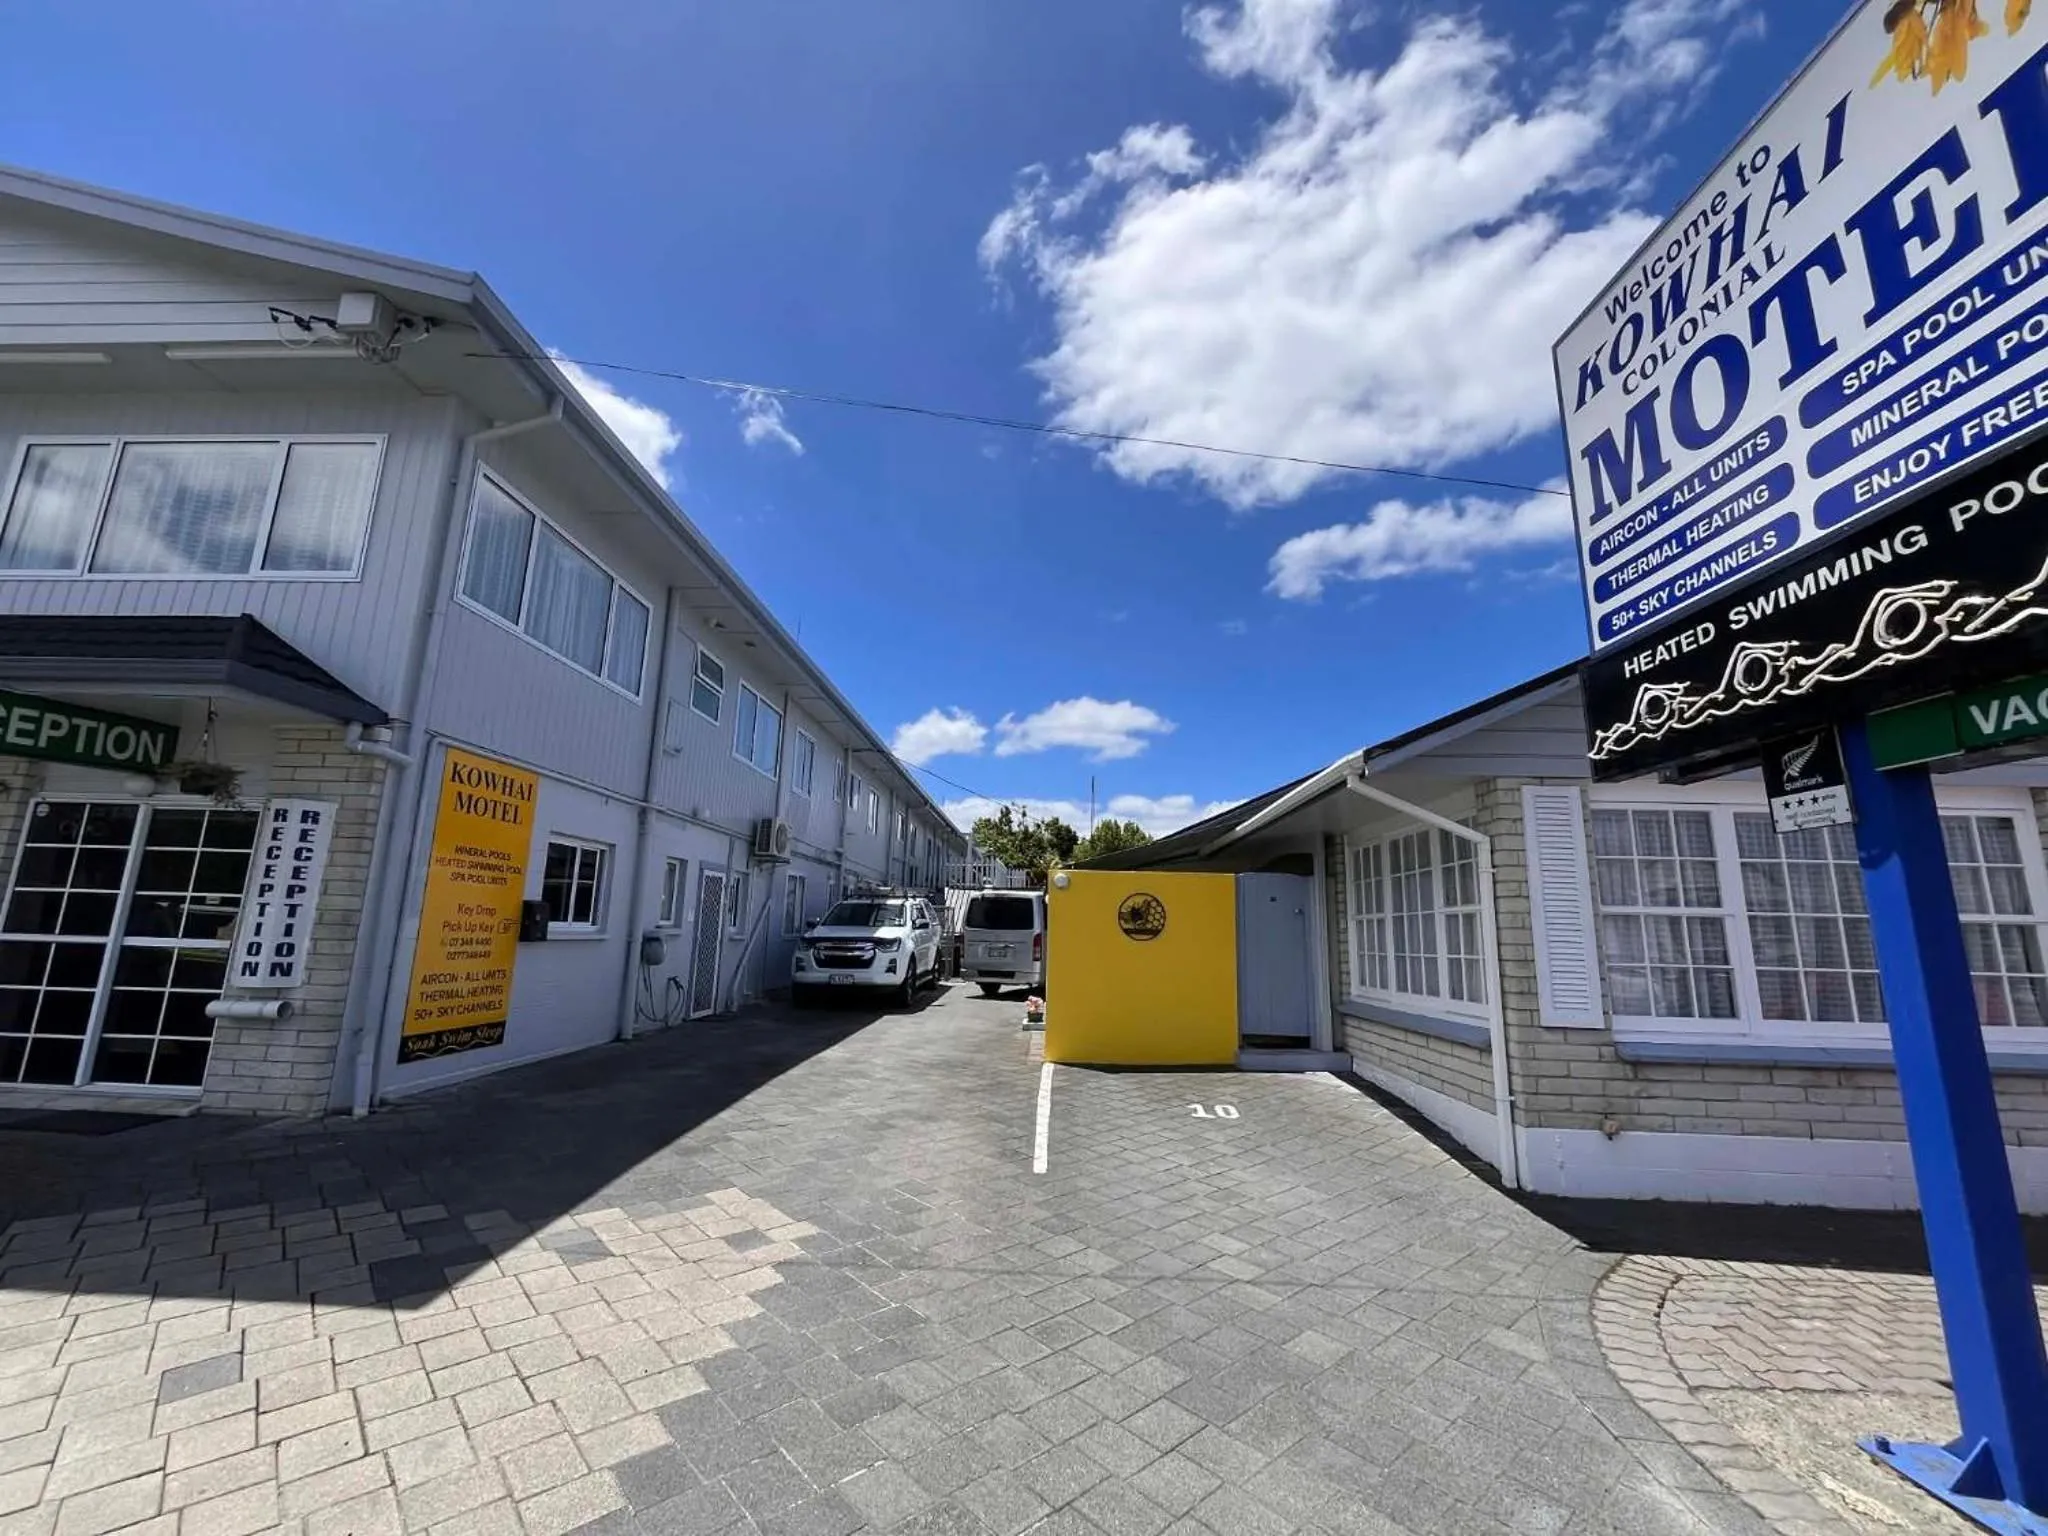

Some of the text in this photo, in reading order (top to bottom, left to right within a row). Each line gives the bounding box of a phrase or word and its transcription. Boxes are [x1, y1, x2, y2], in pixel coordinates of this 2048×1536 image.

[1574, 89, 1853, 414] KOWHAI
[1604, 144, 1771, 325] Welcome to
[1622, 240, 1786, 397] COLONIAL
[1841, 349, 1898, 395] SPA
[1902, 286, 1996, 355] POOL
[1851, 355, 1989, 448] MINERAL
[1600, 508, 1659, 556] AIRCON
[1672, 479, 1707, 511] ALL
[1709, 430, 1770, 482] UNITS
[1853, 432, 1952, 503] ENJOY
[1608, 484, 1769, 590] THERMAL HEATING
[1611, 530, 1777, 631] 50+ SKY CHANNELS
[1623, 621, 1716, 679] HEATED
[1728, 523, 1929, 631] SWIMMING
[0, 703, 165, 766] EPTION
[450, 761, 534, 803] KOWHAI
[454, 790, 524, 825] MOTEL
[241, 807, 290, 978] RECEPTION
[269, 808, 322, 978] RECEPTION
[435, 856, 467, 869] HEATED
[442, 920, 494, 934] Pick Up Key
[457, 903, 497, 918] Key Drop
[419, 984, 504, 1003] THERMAL HEATING
[420, 972, 458, 986] AIRCON
[464, 971, 481, 982] ALL
[482, 968, 507, 981] UNITS
[437, 1006, 456, 1017] SKY
[456, 999, 503, 1016] CHANNELS
[1186, 1104, 1240, 1119] 10
